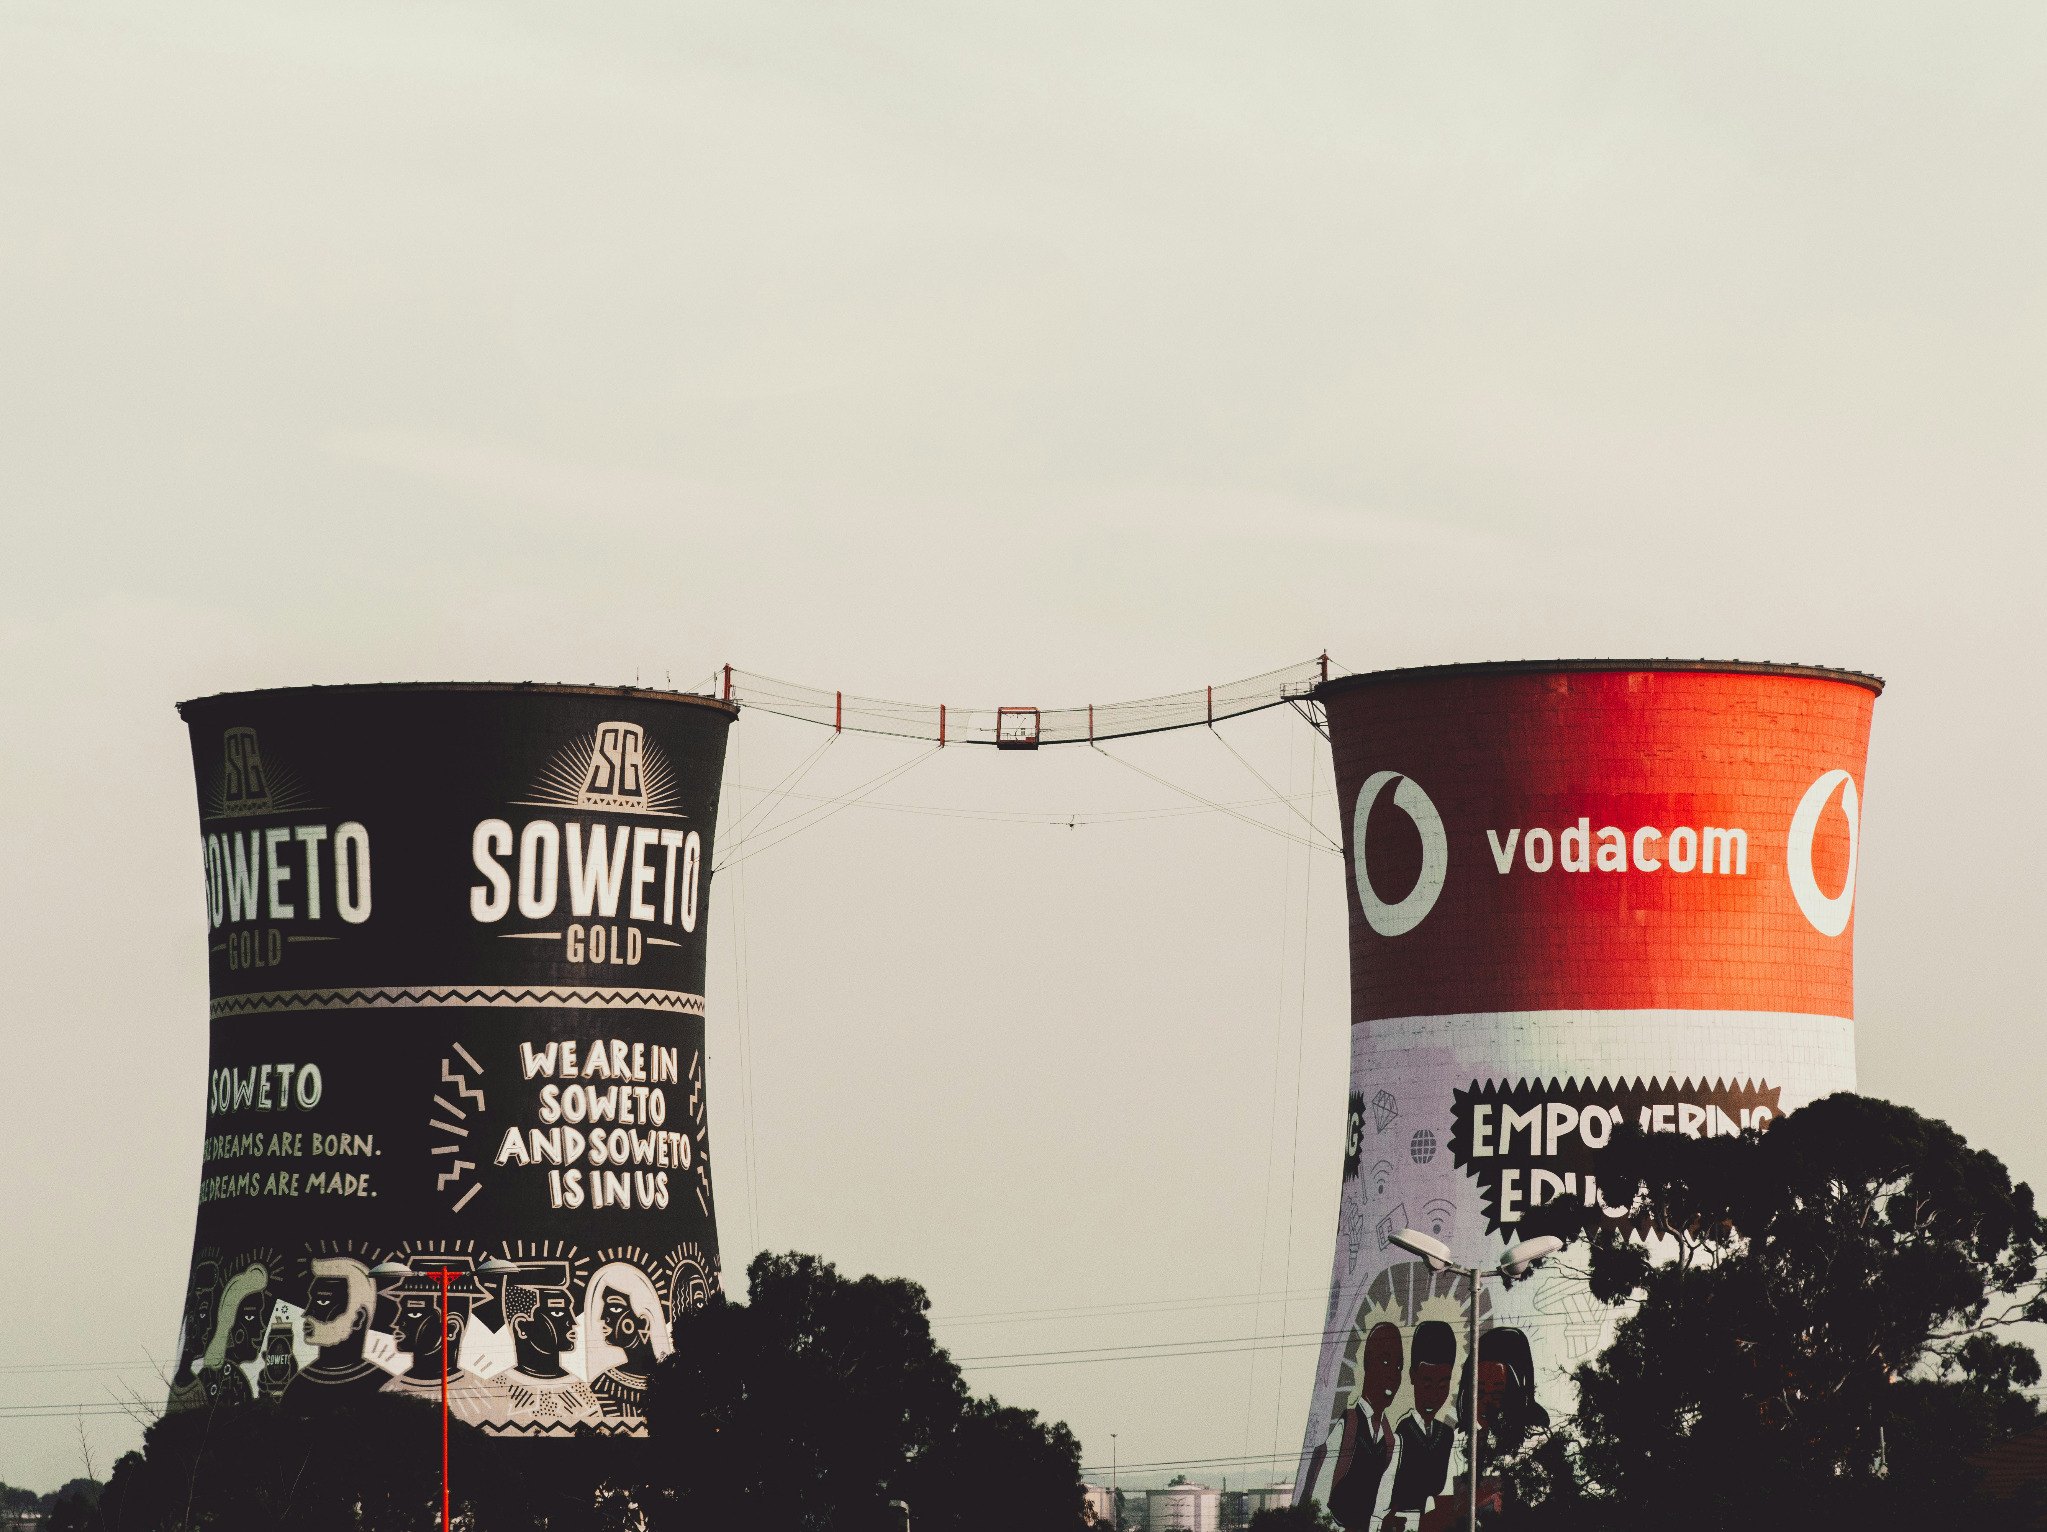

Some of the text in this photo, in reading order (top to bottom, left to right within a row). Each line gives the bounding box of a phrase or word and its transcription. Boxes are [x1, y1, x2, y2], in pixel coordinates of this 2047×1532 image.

[1486, 817, 1748, 875] vodacom
[471, 818, 701, 933] SOWETO
[229, 928, 282, 971] GOLD
[566, 923, 643, 966] GOLD
[519, 1038, 678, 1085] WE ARE IN
[210, 1062, 323, 1118] SOWETO
[538, 1083, 666, 1127] SOWETO
[212, 1131, 264, 1163] DREAMS
[267, 1131, 303, 1158] ARE
[312, 1132, 382, 1158] BORN.
[494, 1125, 692, 1171] AND SOWETO
[208, 1171, 261, 1203] DREAMS
[264, 1170, 300, 1198] ARE
[305, 1171, 378, 1198] MADE.
[548, 1168, 669, 1210] IS IN US
